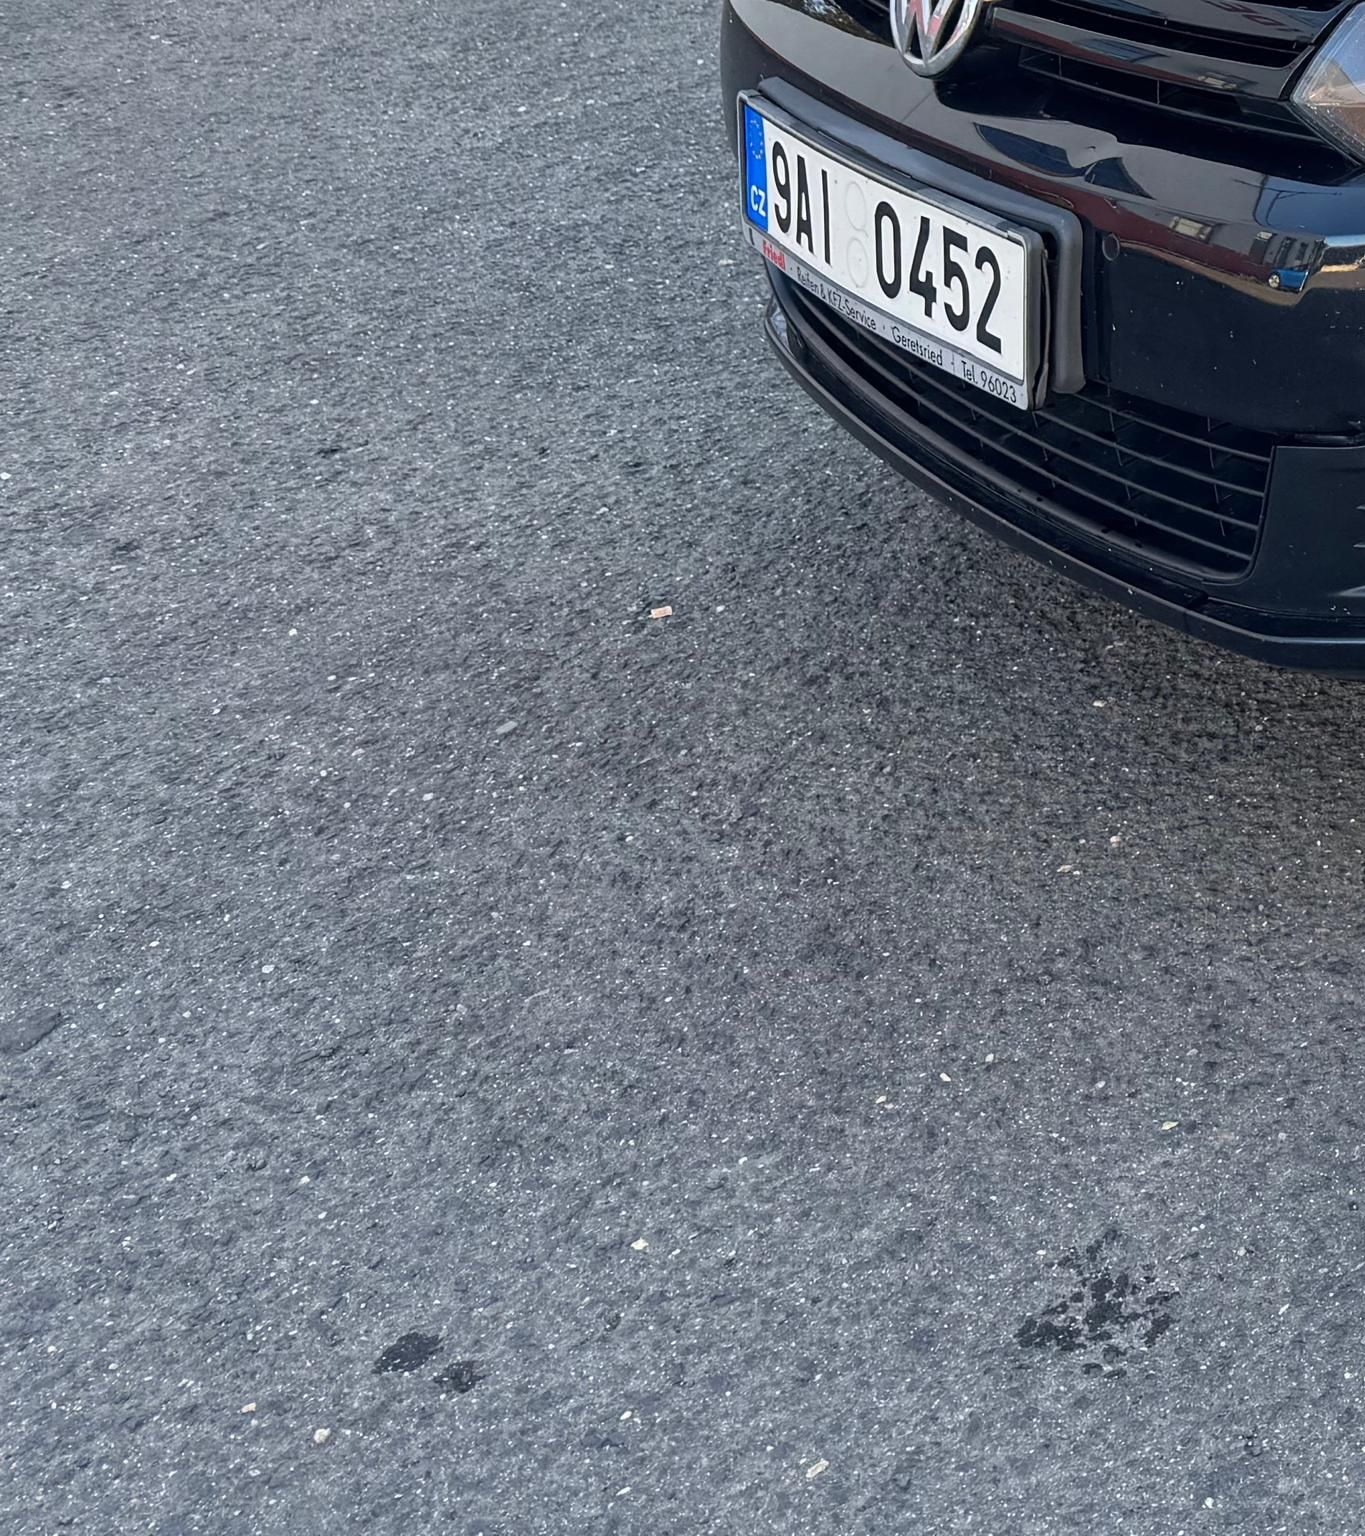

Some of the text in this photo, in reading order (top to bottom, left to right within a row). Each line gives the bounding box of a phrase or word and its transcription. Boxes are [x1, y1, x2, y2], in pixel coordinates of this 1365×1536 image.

[750, 184, 767, 217] CZ
[772, 140, 1002, 355] 9AI 0452
[826, 287, 877, 330] KFZ-Service
[891, 325, 943, 366] Geretsried
[961, 360, 978, 385] Tel.
[981, 370, 1017, 404] 96023
